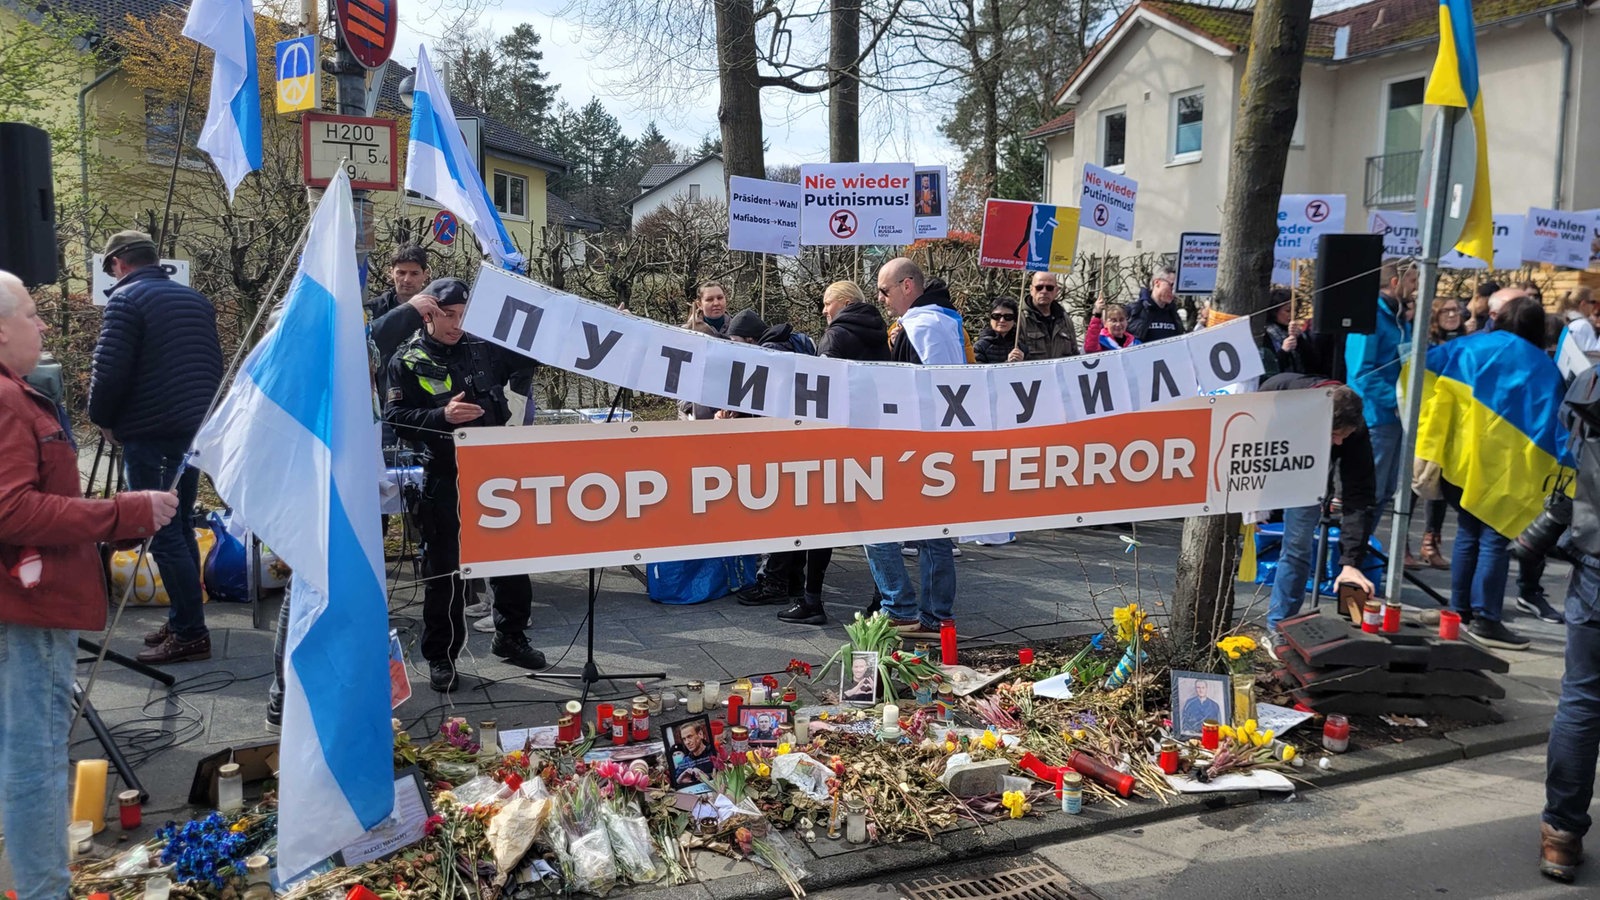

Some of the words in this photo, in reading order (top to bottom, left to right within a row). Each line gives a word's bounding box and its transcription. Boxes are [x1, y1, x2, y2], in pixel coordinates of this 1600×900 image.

[805, 173, 836, 189] Nie
[842, 173, 910, 189] wieder
[1085, 171, 1101, 186] Nie
[1104, 180, 1136, 199] wieder
[804, 192, 909, 206] Putinismus!
[1083, 185, 1134, 212] Putinismus!
[733, 213, 770, 225] Mafiaboss
[777, 219, 797, 228] Knast
[1279, 224, 1313, 234] eder
[1536, 216, 1586, 233] Wahlen
[1277, 236, 1301, 247] tin!
[1560, 232, 1585, 242] Wahl
[492, 295, 831, 420] ПУТИН
[936, 341, 1241, 427] ХУЙЛО
[1231, 440, 1290, 458] FREIES
[1230, 455, 1315, 475] RUSSLAND
[477, 470, 668, 529] STOP
[972, 438, 1196, 493] TERROR
[1229, 474, 1267, 492] NRW
